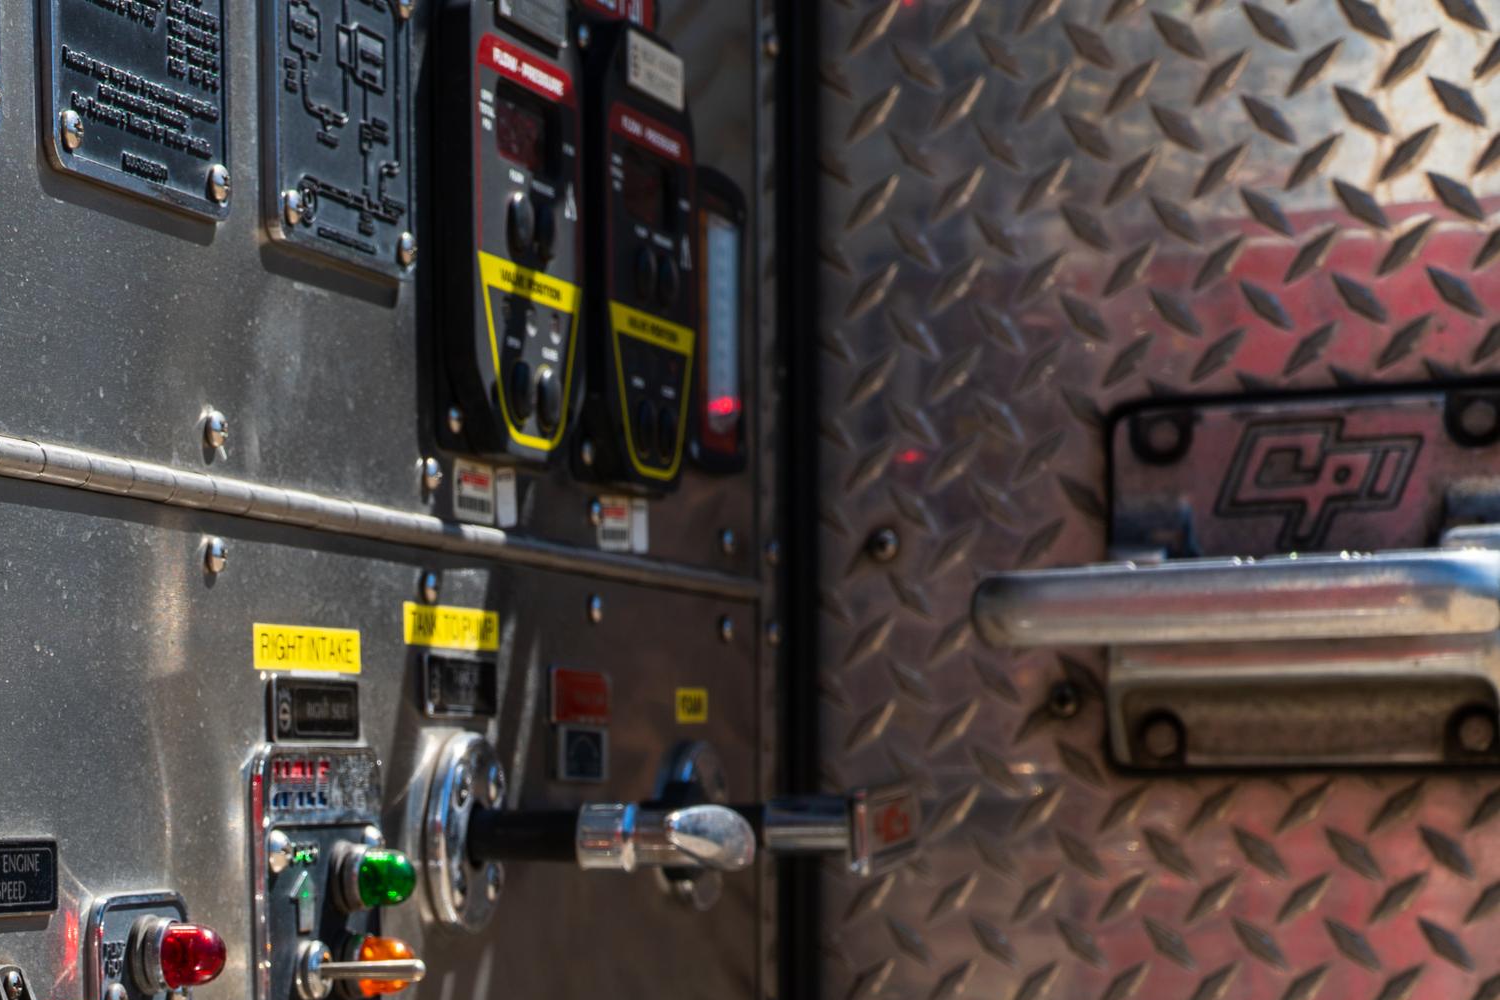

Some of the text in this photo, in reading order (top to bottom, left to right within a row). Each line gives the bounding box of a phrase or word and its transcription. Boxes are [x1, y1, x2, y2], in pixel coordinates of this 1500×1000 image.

[261, 632, 353, 664] RIGHT INTAKE
[2, 853, 41, 874] ENGINE
